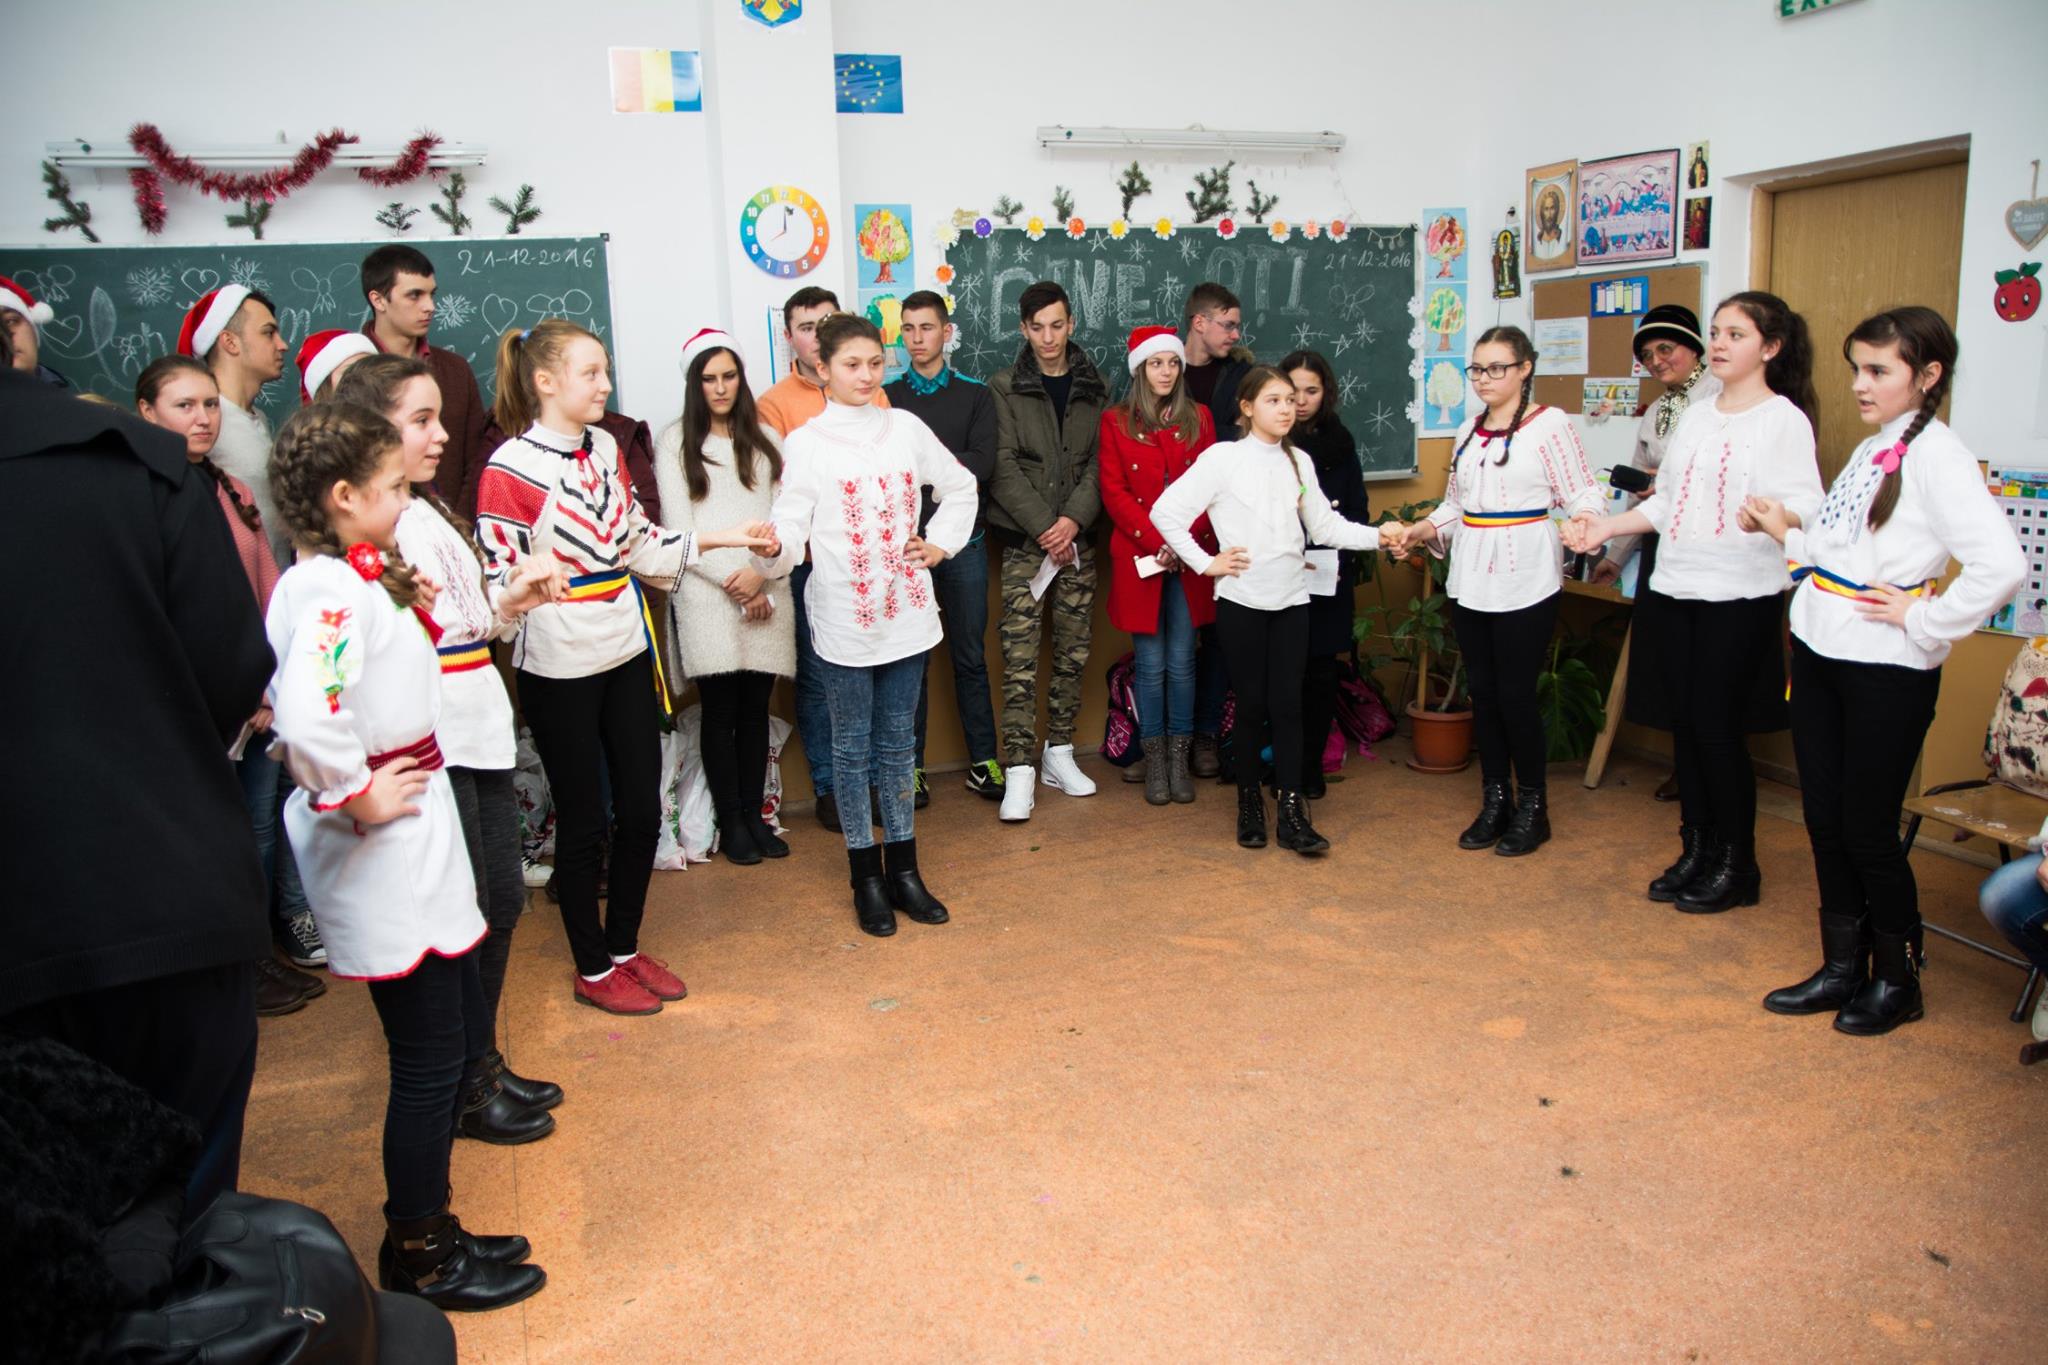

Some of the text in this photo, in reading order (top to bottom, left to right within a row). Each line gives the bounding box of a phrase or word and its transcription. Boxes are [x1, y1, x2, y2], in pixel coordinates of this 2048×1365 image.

[747, 207, 757, 217] 10
[812, 209, 818, 218] 2
[746, 226, 754, 236] 9
[817, 227, 823, 236] 3
[752, 244, 758, 254] 8
[813, 246, 819, 255] 4
[766, 260, 772, 269] 7
[802, 260, 808, 269] 5
[784, 265, 790, 274] 6
